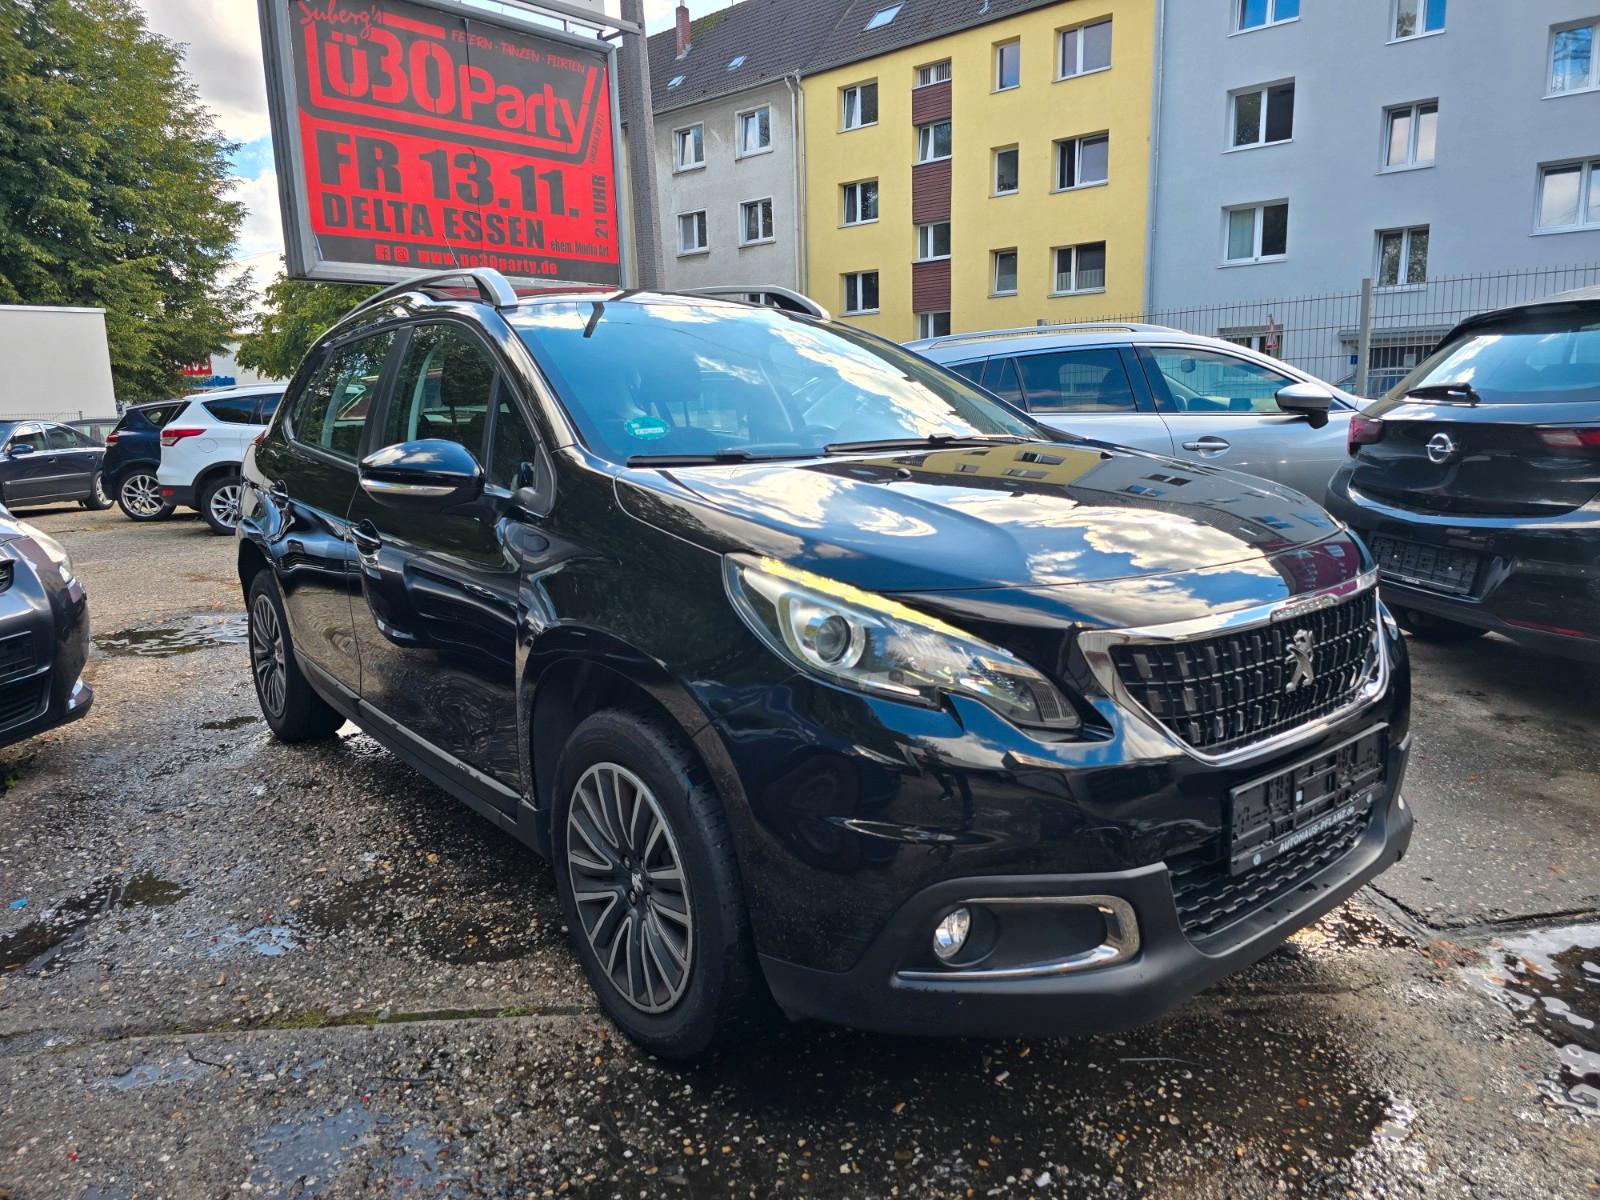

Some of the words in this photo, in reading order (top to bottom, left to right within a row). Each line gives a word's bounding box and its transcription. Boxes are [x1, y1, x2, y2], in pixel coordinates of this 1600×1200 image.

[451, 29, 492, 50] FEIERN
[501, 42, 540, 62] TANZEN
[315, 129, 402, 193] FR
[418, 149, 579, 218] 13.11.
[592, 173, 608, 214] UHR
[320, 192, 433, 237] DELTA
[444, 207, 545, 249] ESSEN
[594, 218, 609, 240] 21
